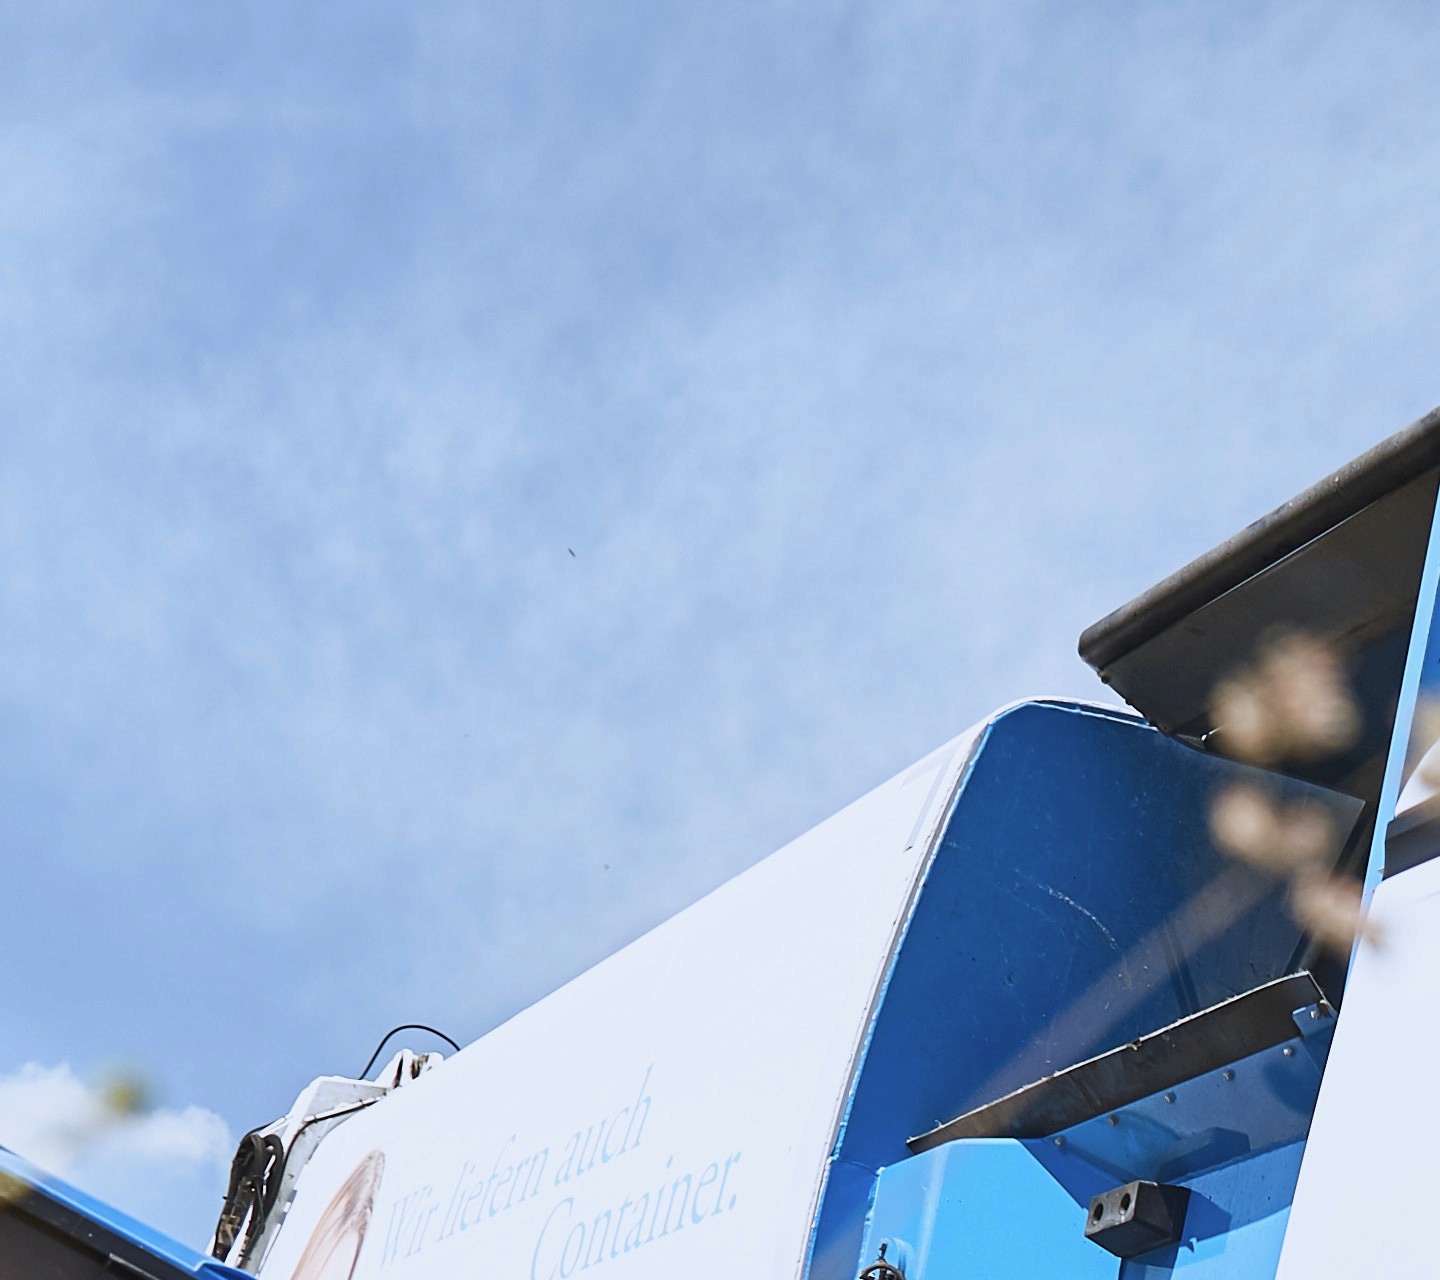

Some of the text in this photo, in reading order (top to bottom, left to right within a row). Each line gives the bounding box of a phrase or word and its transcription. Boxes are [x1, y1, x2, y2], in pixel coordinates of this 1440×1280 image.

[380, 1061, 655, 1270] Wir liefern auch
